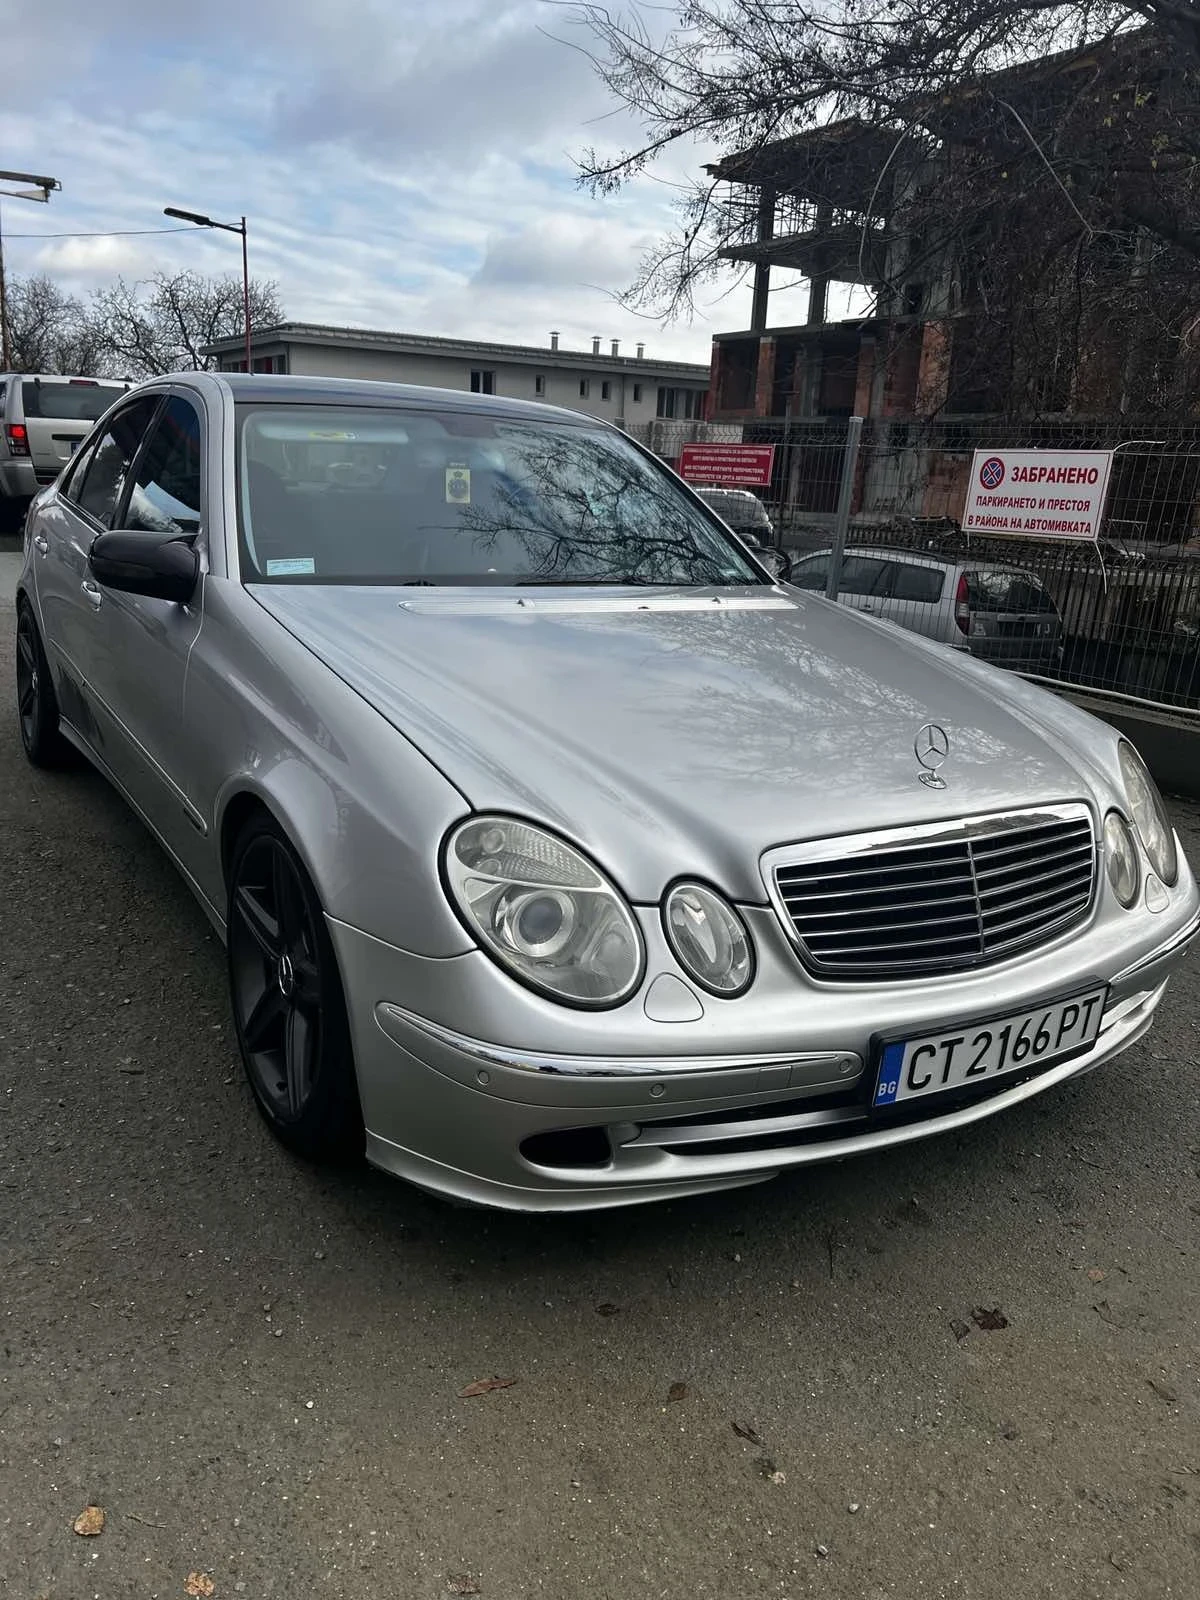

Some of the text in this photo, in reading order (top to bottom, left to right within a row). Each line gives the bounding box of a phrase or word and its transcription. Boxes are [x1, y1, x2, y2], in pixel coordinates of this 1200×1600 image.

[1011, 466, 1098, 484] ЗАБРАНЕНО
[976, 495, 1091, 512] ПАРКИРАНЕТО И ПРЕСТОЯ
[967, 514, 1091, 534] В РАЙОНА НА АВТОМИВКАТА
[907, 995, 1101, 1091] CT 2166 PT
[878, 1080, 897, 1097] BG
